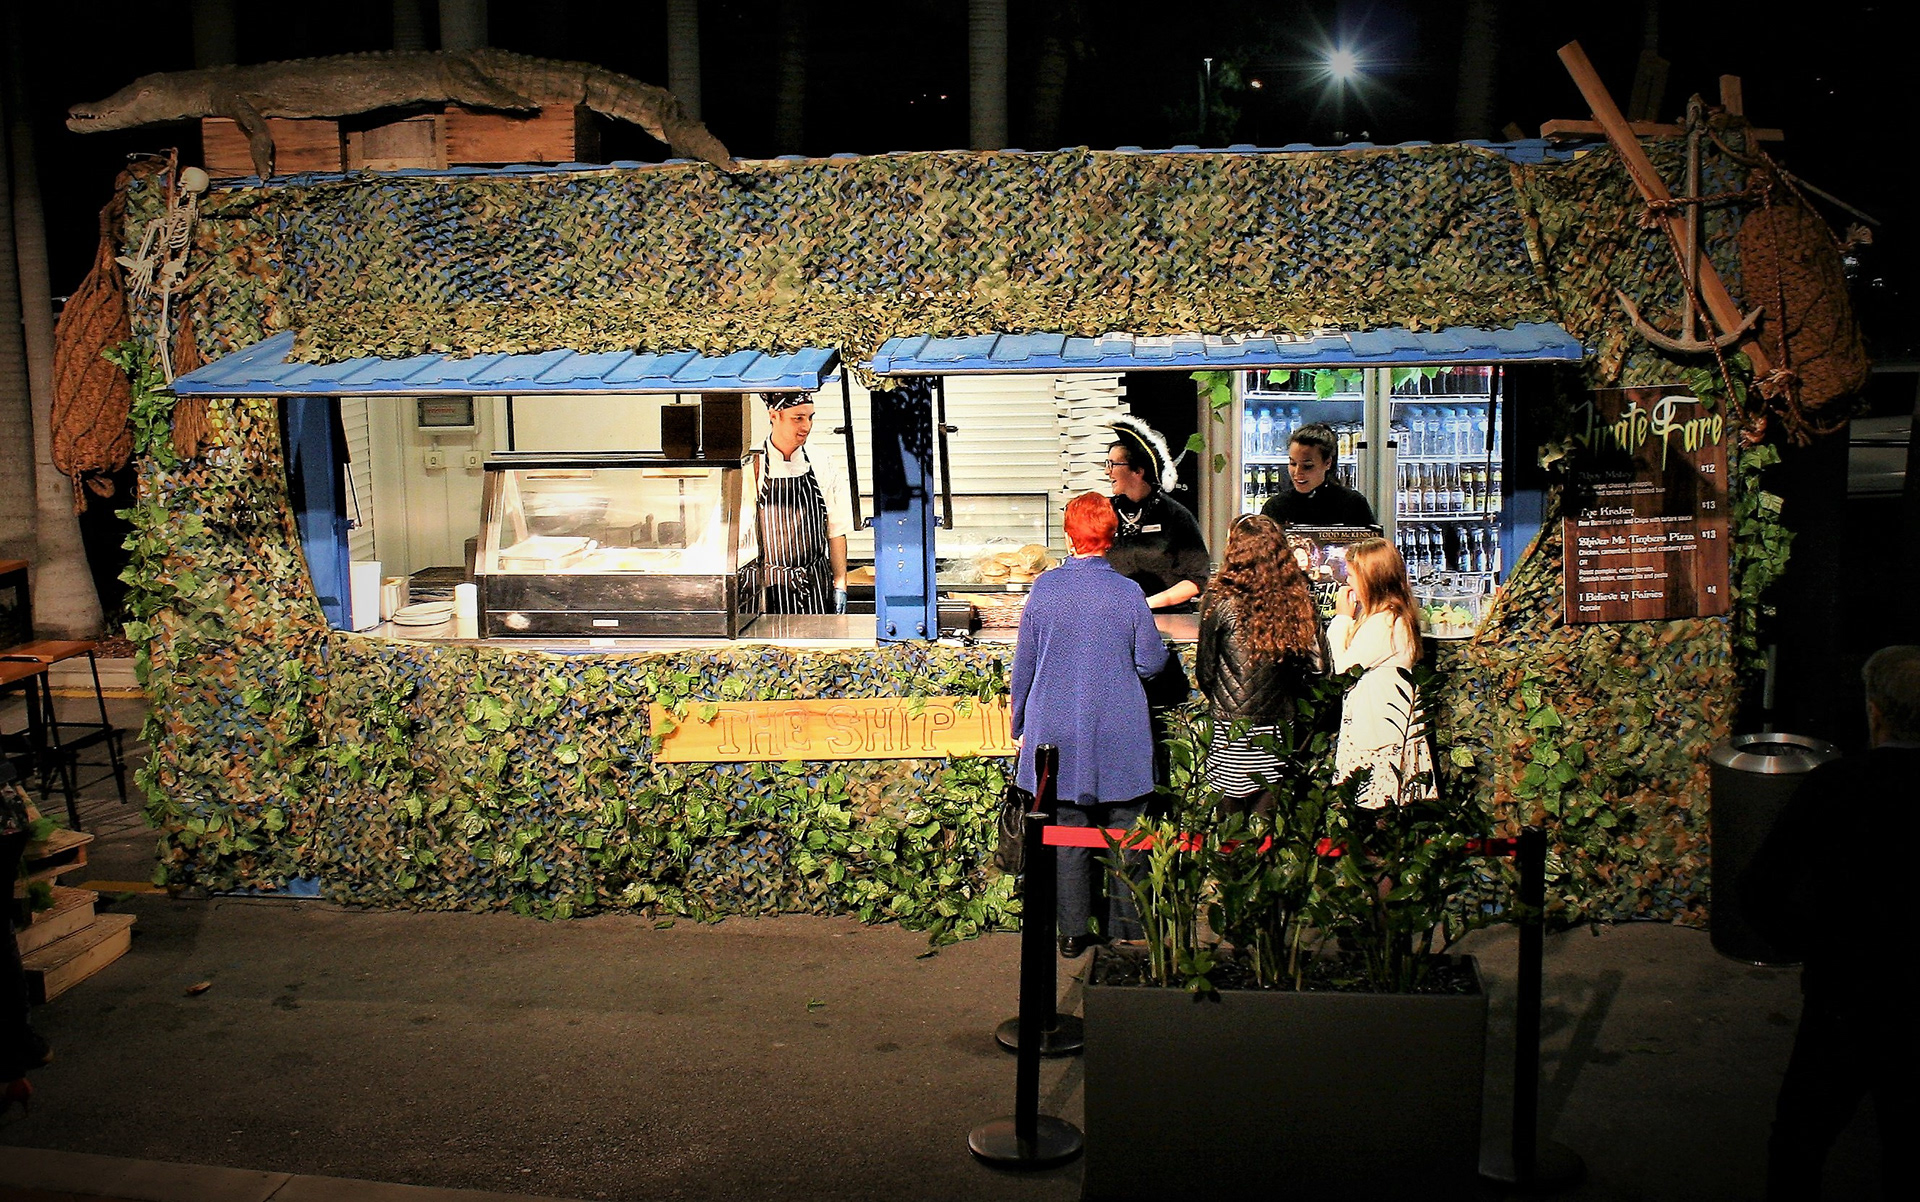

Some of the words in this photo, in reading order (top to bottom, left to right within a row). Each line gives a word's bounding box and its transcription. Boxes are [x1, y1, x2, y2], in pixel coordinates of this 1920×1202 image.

[1571, 400, 1648, 457] Pirate
[1652, 395, 1723, 471] Fare
[1701, 464, 1716, 473] $12
[1702, 500, 1716, 509] $13
[1580, 508, 1598, 519] The
[1600, 506, 1635, 517] Kraken
[1634, 517, 1649, 525] Chips
[1702, 530, 1716, 539] $13
[1578, 537, 1610, 548] Shiver
[1611, 536, 1626, 545] Me
[1629, 534, 1667, 546] Timbers
[1669, 532, 1695, 541] Pizza
[1578, 593, 1583, 602] I
[1585, 592, 1619, 602] Believe
[1620, 591, 1630, 602] in
[1631, 590, 1664, 600] Fairies
[1579, 604, 1601, 612] Cupcake
[717, 706, 811, 756] THE
[825, 703, 955, 755] SHIP
